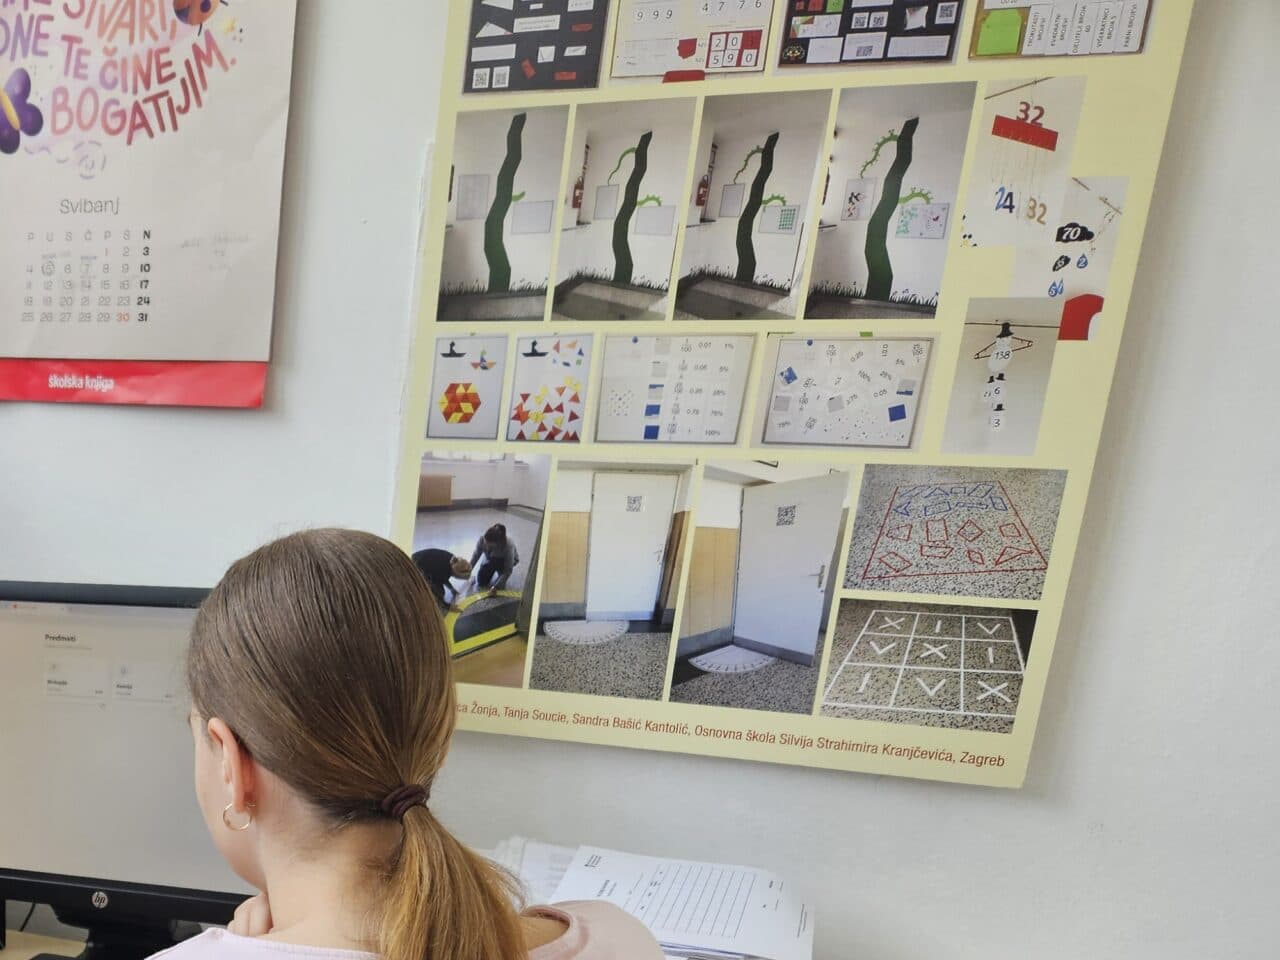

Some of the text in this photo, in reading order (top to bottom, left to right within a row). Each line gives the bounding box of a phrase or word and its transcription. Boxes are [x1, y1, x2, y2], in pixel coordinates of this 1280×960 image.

[636, 9, 673, 21] 9 9 9
[715, 38, 722, 48] 2
[61, 34, 176, 95] TE ČINE
[713, 55, 720, 65] 5
[727, 53, 734, 64] 9
[50, 29, 237, 146] BOGATIJIM.
[1017, 101, 1045, 127] 32
[60, 197, 120, 215] Svibanj
[1026, 197, 1048, 225] 32
[143, 230, 151, 240] N
[1061, 226, 1081, 240] 70
[142, 246, 150, 256] 3
[140, 263, 151, 273] 10
[140, 279, 150, 289] 17
[137, 296, 151, 305] 24
[138, 312, 148, 322] 31
[995, 350, 1011, 361] 138
[48, 373, 115, 392] školska knjiga
[994, 387, 1001, 395] 6
[994, 418, 1001, 428] 3
[471, 701, 501, 718] Žonja,
[503, 706, 529, 720] Tanja
[532, 709, 569, 724] Soucie,
[572, 713, 609, 727] Sandra
[613, 716, 642, 730] Bašić
[645, 720, 691, 736] Kantolić,
[695, 725, 742, 740] Osnovna
[746, 729, 776, 744] škola
[779, 733, 813, 749] Silvija
[816, 737, 878, 754] Strahimira
[882, 743, 956, 764] Kranjčevića,
[960, 751, 1006, 768] Zagreb
